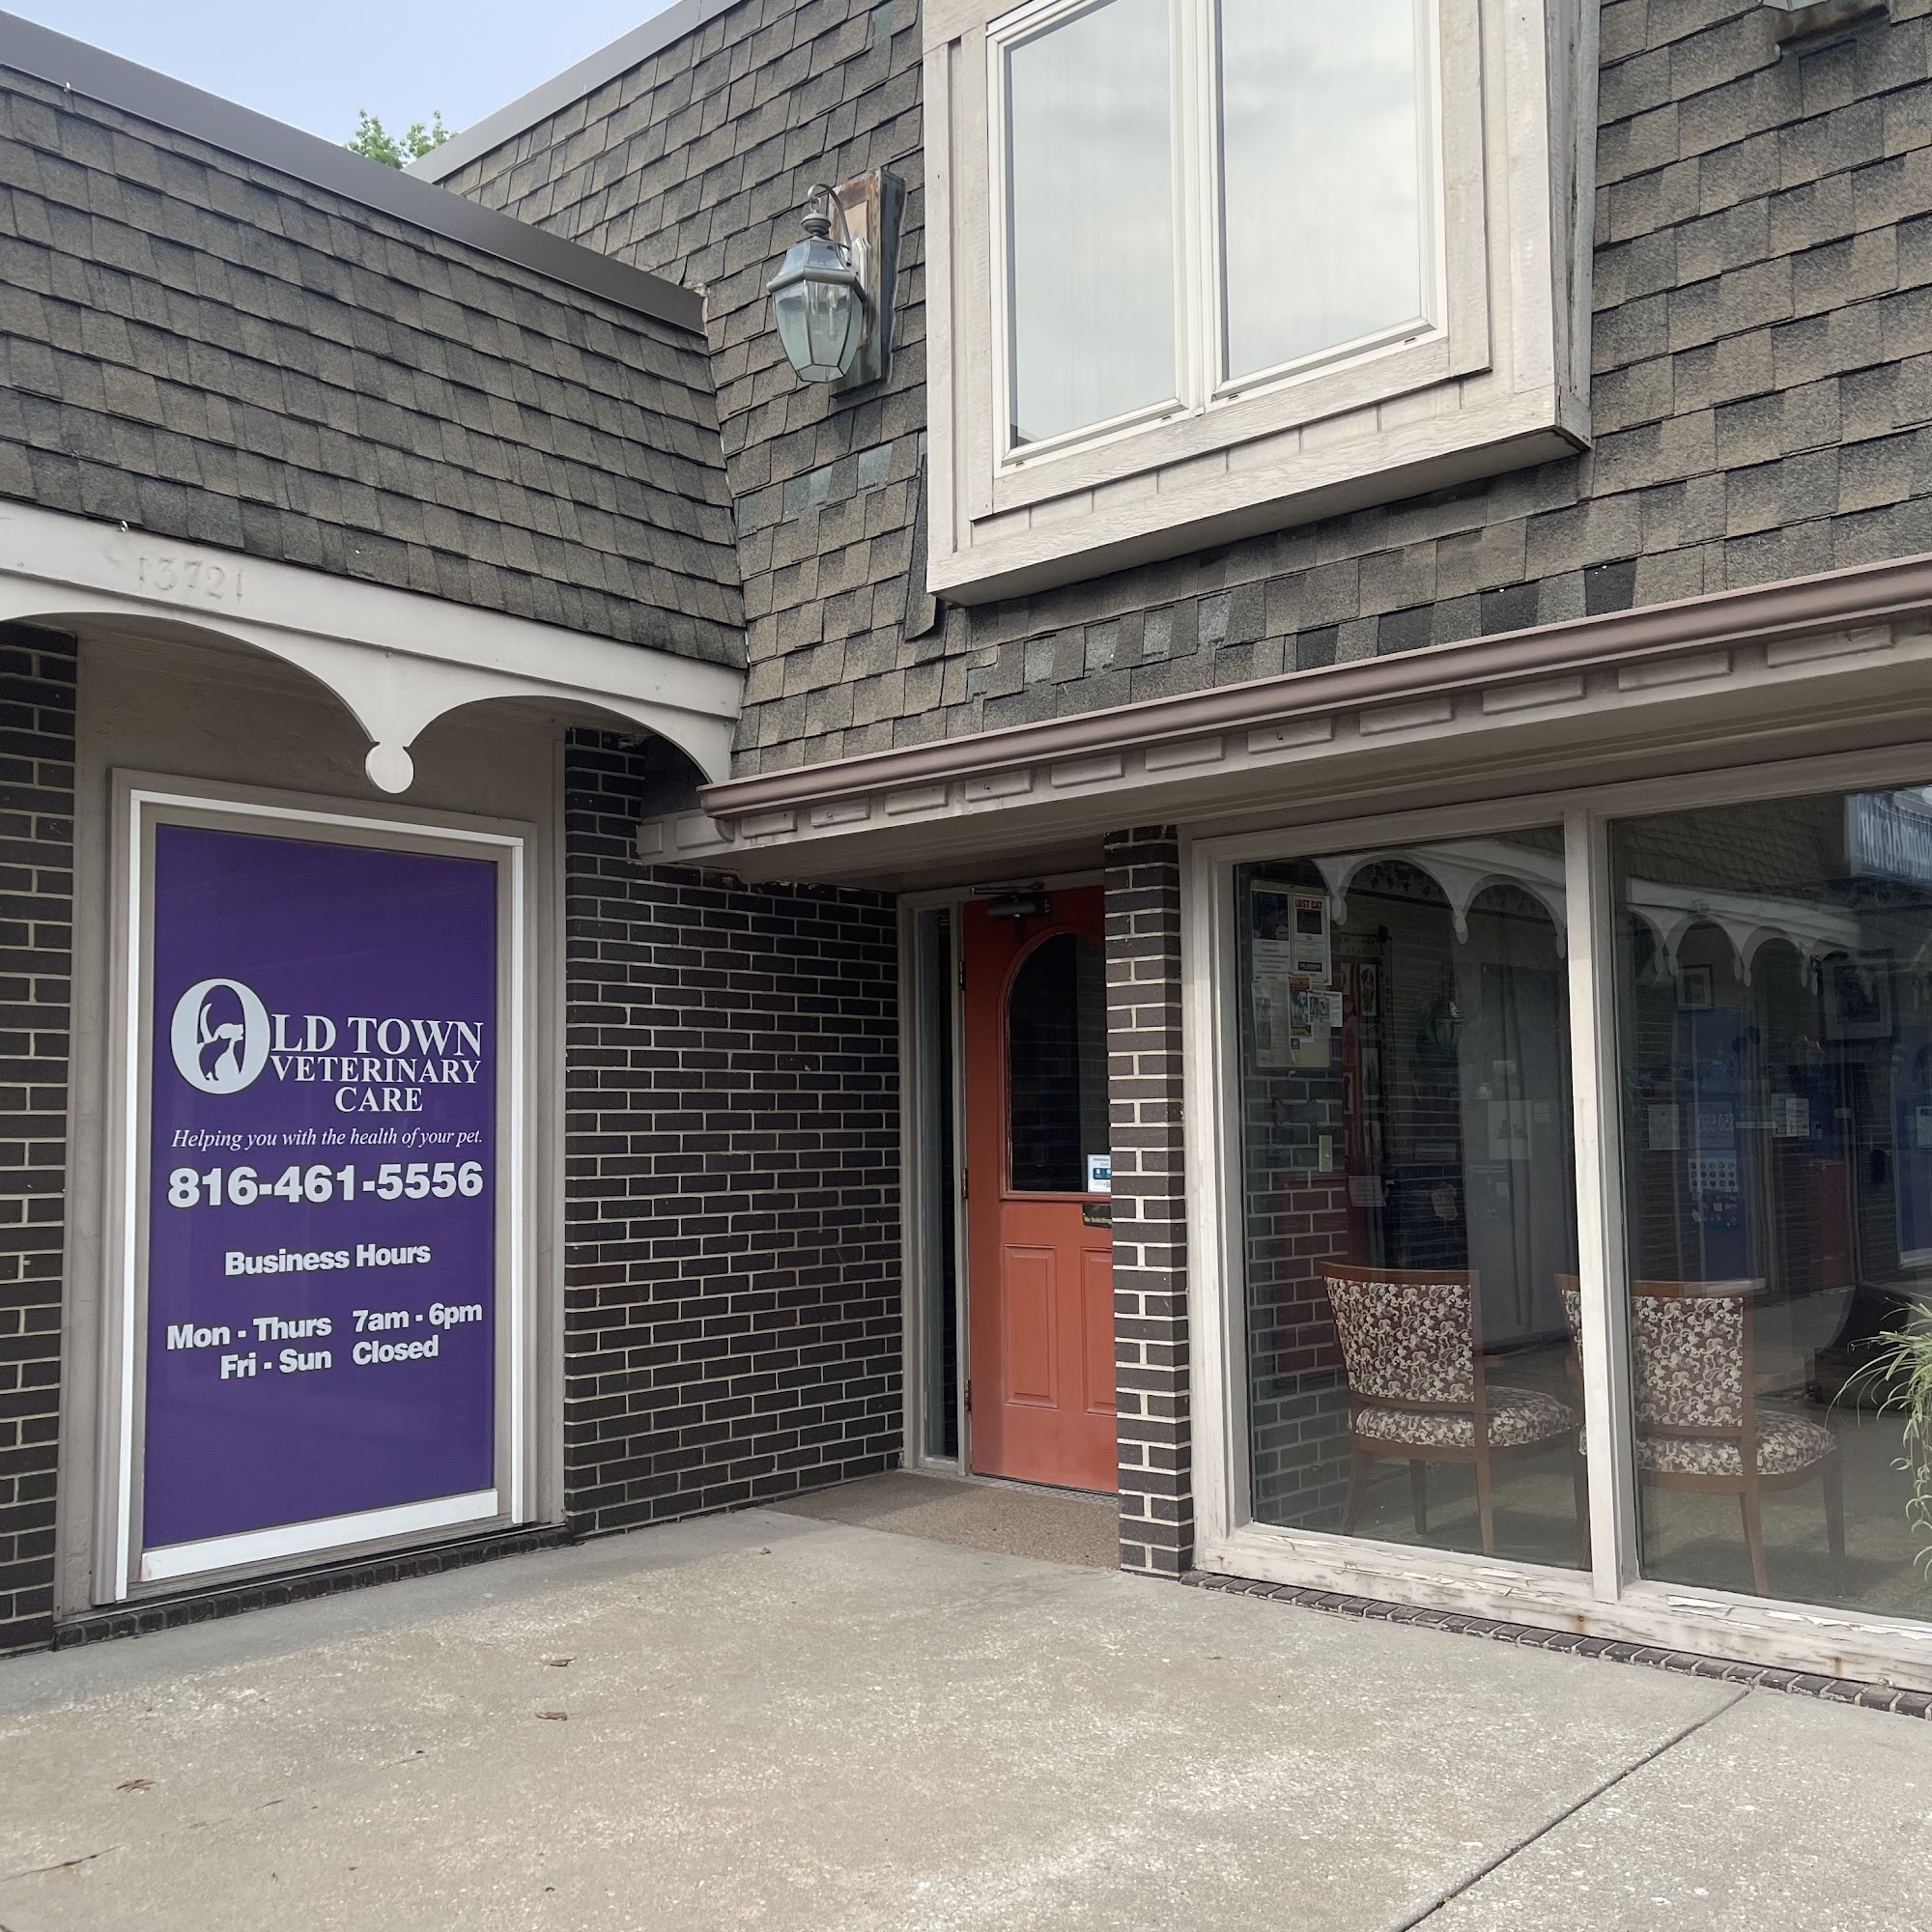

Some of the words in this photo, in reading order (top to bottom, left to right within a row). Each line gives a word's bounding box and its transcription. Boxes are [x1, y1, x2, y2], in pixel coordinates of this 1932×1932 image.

[138, 555, 243, 603] 13721
[1295, 898, 1310, 909] LOST
[1311, 900, 1323, 911] CAT
[171, 979, 337, 1094] OLD
[348, 1017, 483, 1056] TOWN
[270, 1056, 481, 1083] VETERINARY
[335, 1087, 422, 1112] CARE
[172, 1129, 242, 1151] Helping
[245, 1134, 276, 1151] you
[283, 1128, 316, 1145] with
[322, 1128, 345, 1145] the
[351, 1128, 397, 1144] health
[402, 1127, 419, 1148] of
[418, 1133, 454, 1148] your
[456, 1130, 482, 1147] pet.
[168, 1161, 483, 1208] 816-461-5556
[226, 1249, 350, 1275] Business
[356, 1244, 431, 1266] Hours
[167, 1324, 230, 1350] Mon
[253, 1317, 331, 1341] Thurs
[353, 1310, 409, 1332] 7am
[429, 1303, 482, 1329] 6pm
[221, 1352, 256, 1379] Fri
[279, 1349, 331, 1373] Sun
[353, 1335, 439, 1365] Closed
